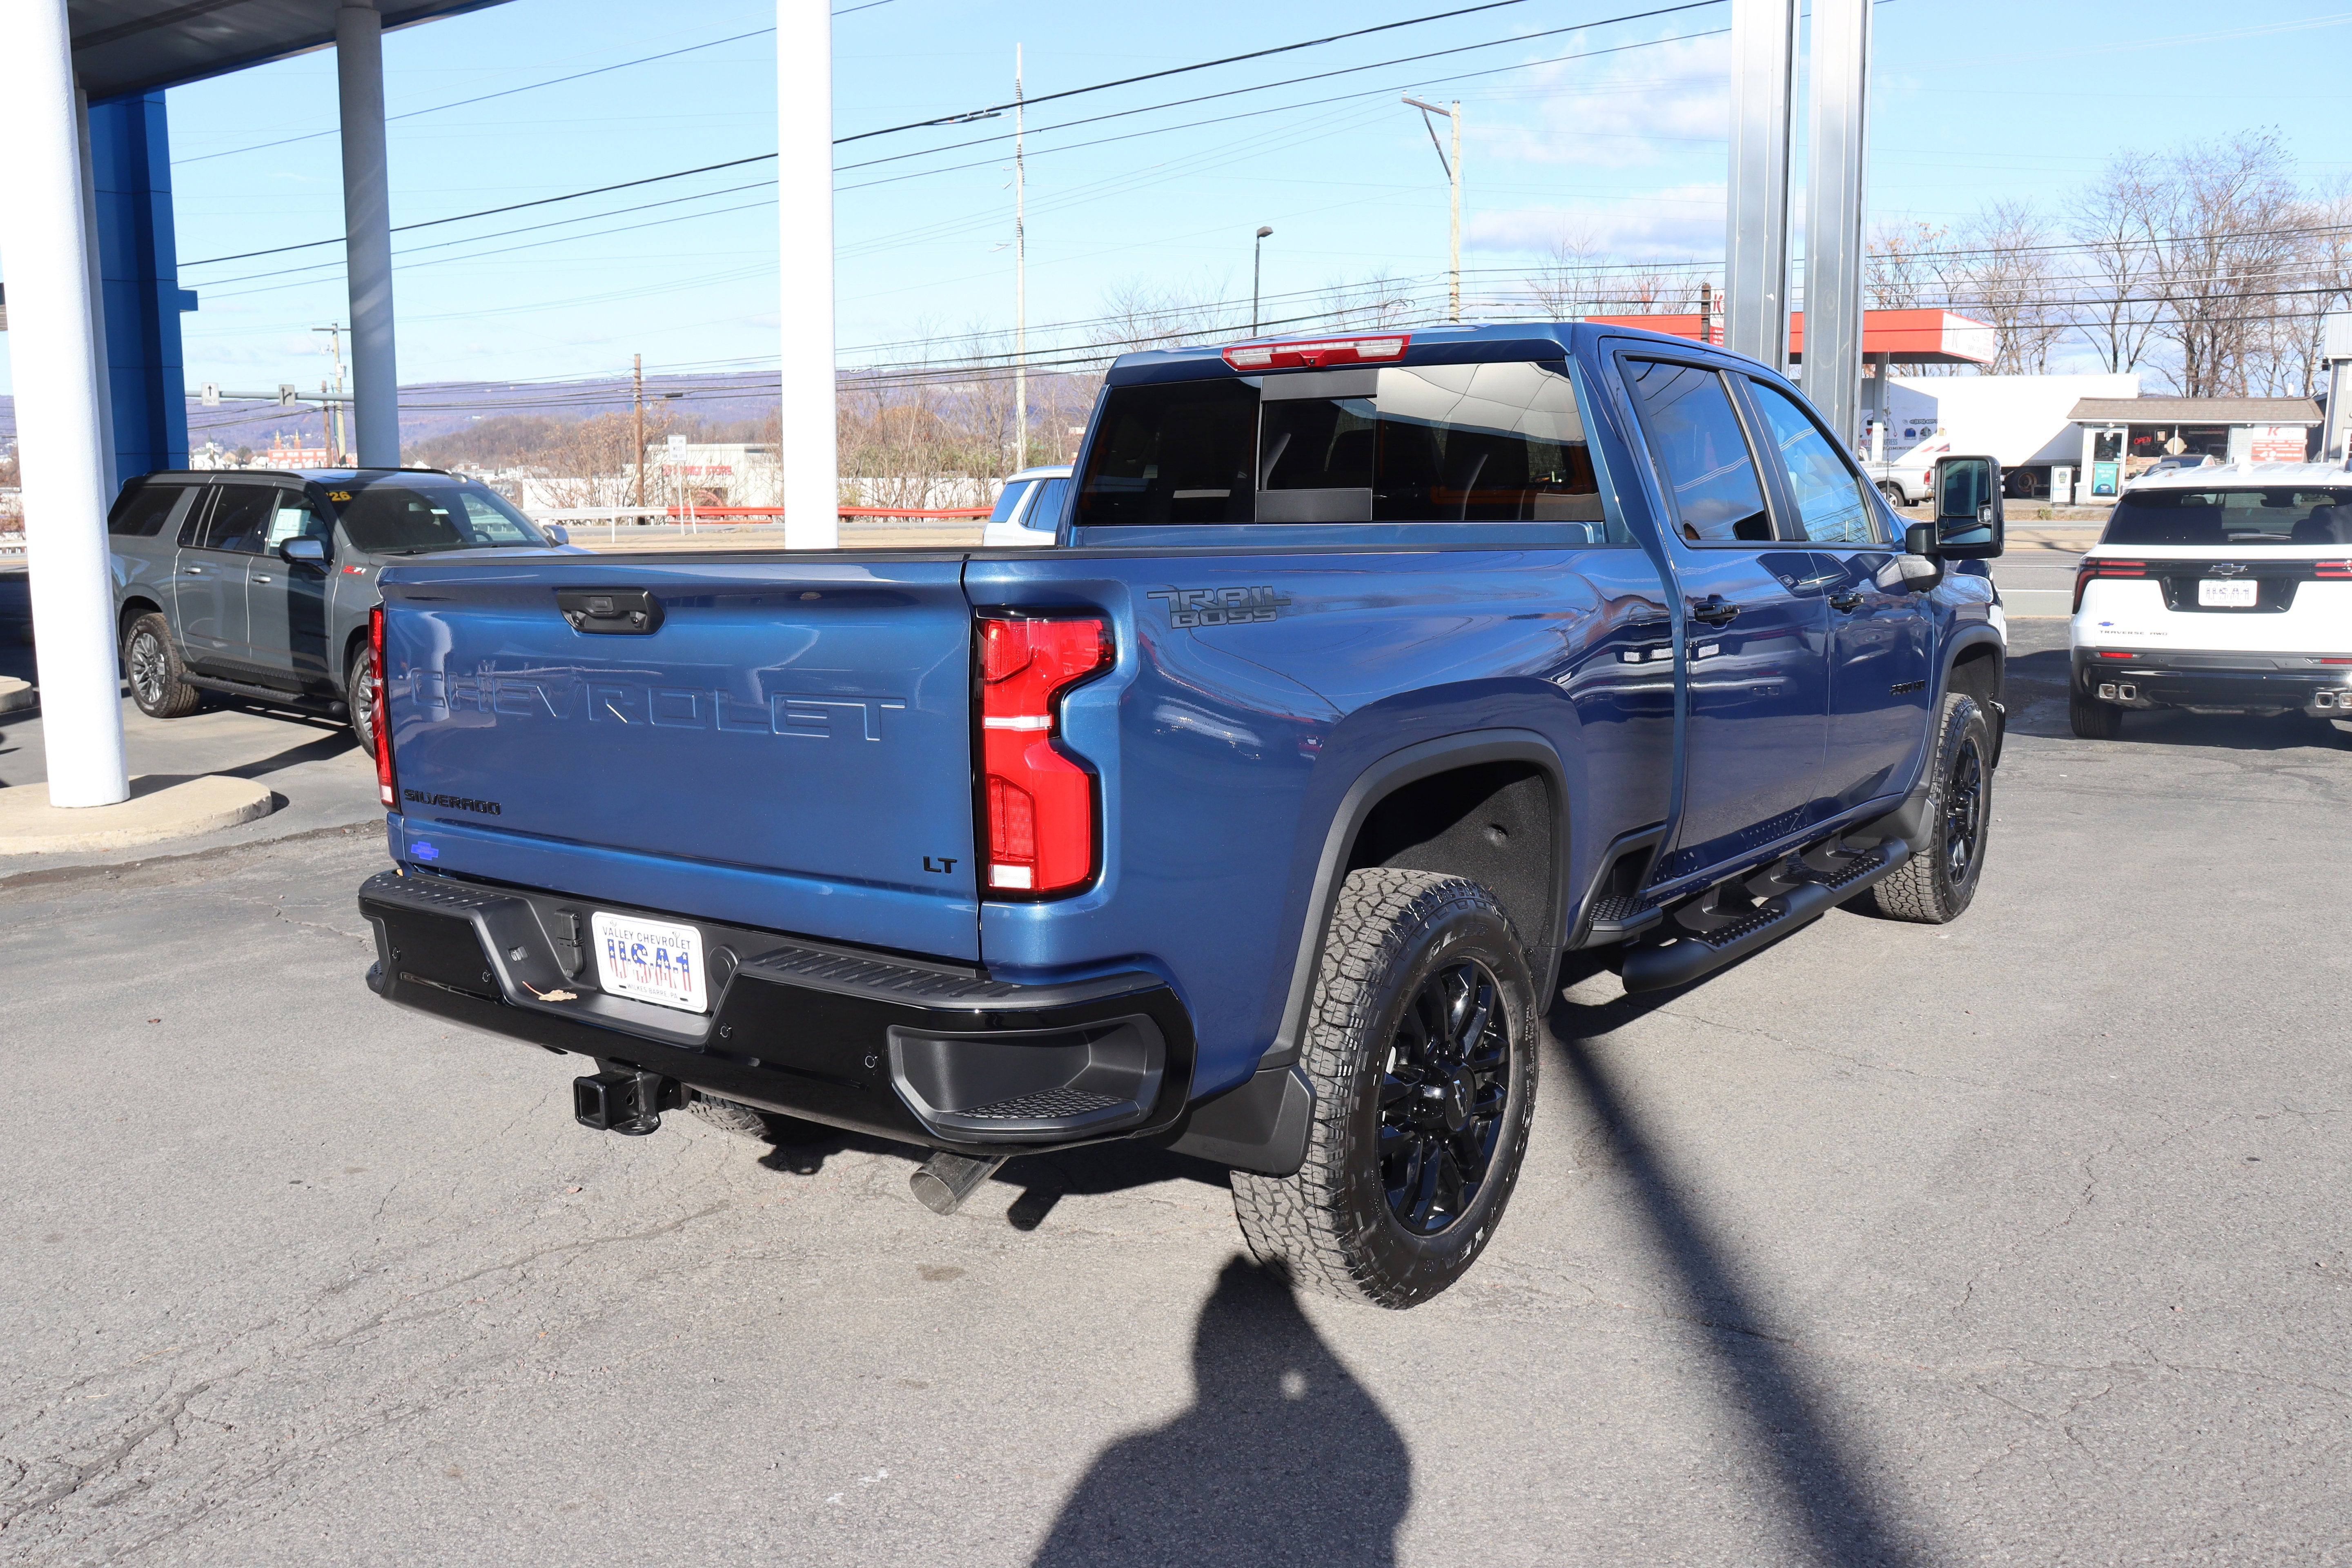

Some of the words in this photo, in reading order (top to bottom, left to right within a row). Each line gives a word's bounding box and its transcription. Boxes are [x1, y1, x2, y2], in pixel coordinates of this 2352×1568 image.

[2134, 436, 2152, 445] OPEN
[343, 565, 366, 575] Z71
[1147, 586, 1292, 611] TRAIL
[1171, 605, 1278, 629] BOSS
[410, 667, 907, 741] CHEVROLET
[404, 788, 501, 815] SILVERADO
[922, 855, 958, 874] LT
[602, 926, 634, 940] VALLEY
[637, 932, 691, 950] CHEVROLET
